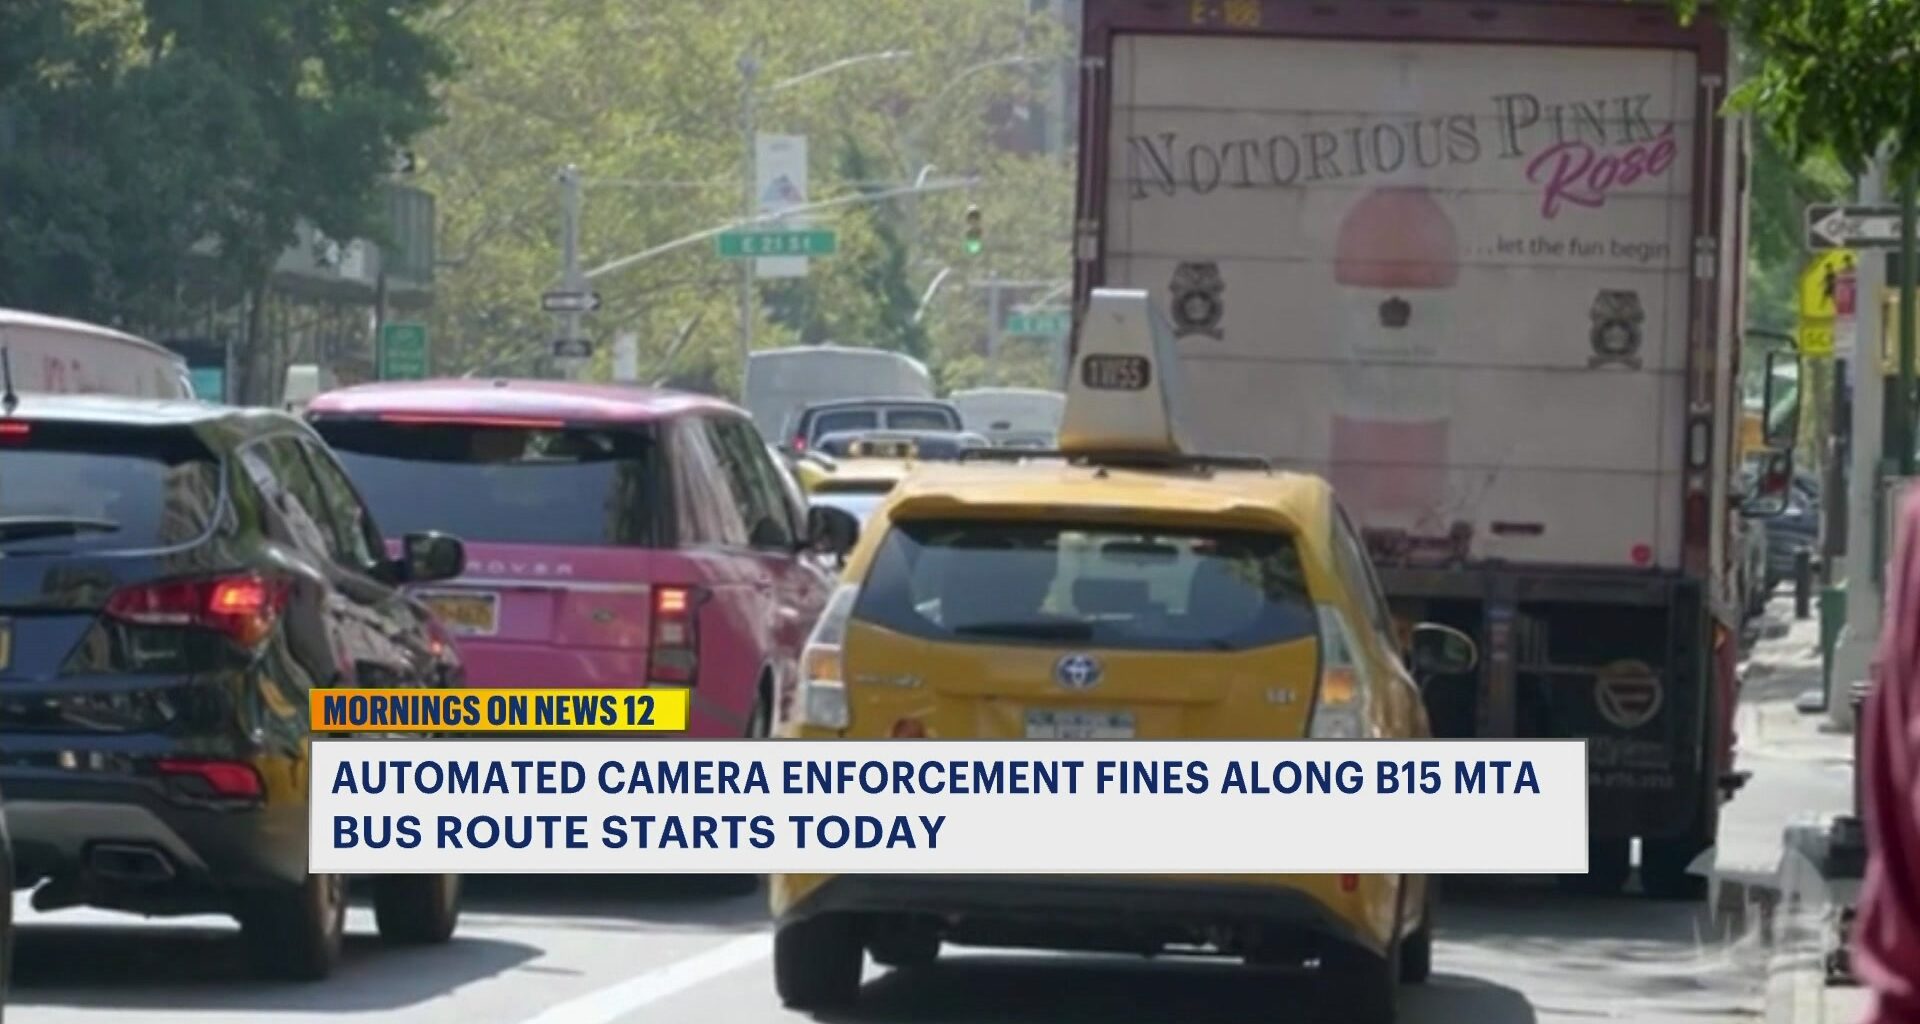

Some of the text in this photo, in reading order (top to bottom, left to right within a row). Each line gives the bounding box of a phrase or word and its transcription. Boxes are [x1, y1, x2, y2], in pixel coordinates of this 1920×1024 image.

[1128, 93, 1656, 200] NOTORIOUS PINK
[1526, 122, 1678, 219] Rosé
[1529, 238, 1565, 257] the
[1569, 238, 1606, 258] fun
[1610, 238, 1671, 262] begin
[466, 560, 574, 576] ROVER
